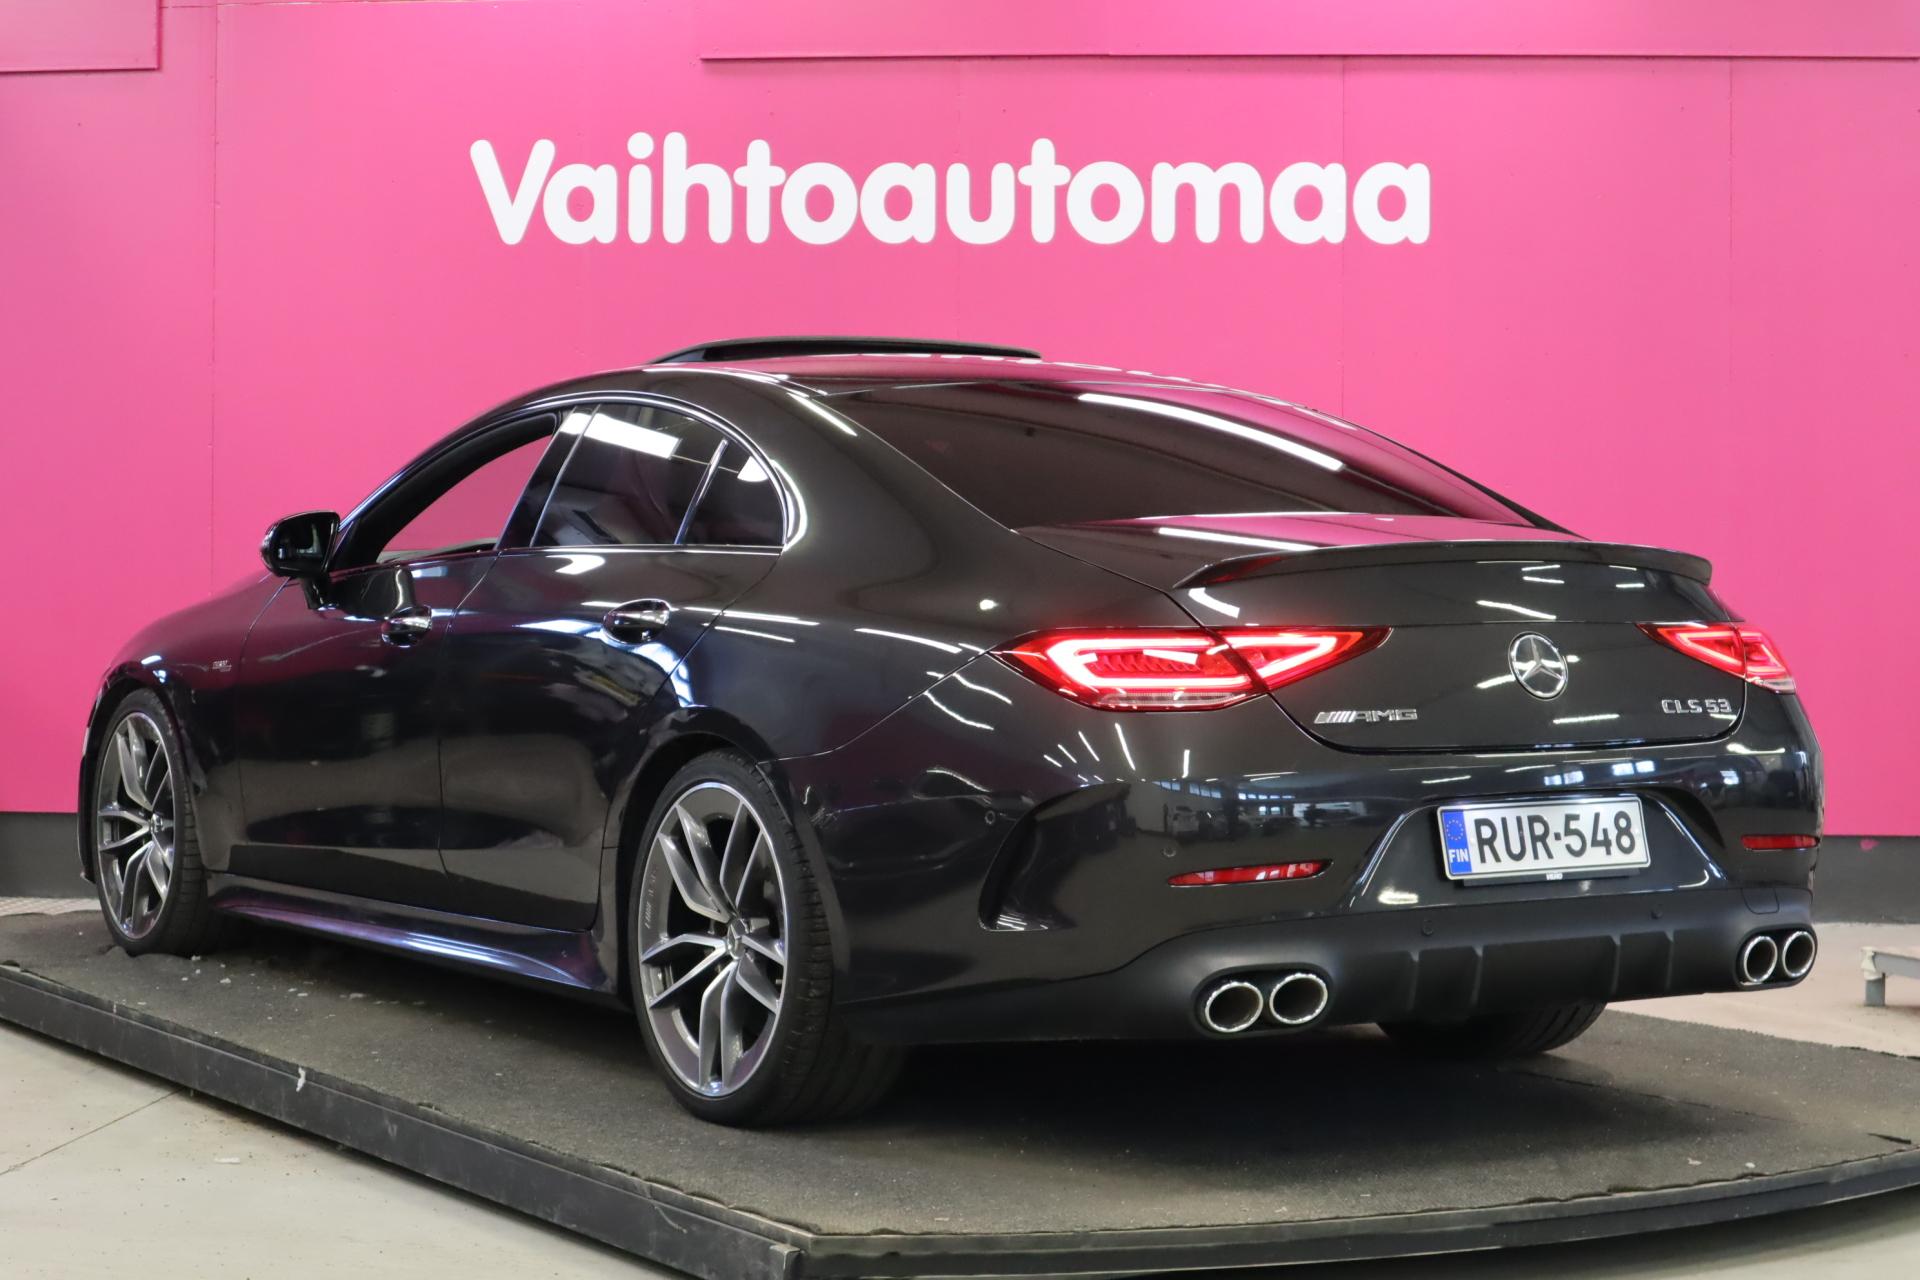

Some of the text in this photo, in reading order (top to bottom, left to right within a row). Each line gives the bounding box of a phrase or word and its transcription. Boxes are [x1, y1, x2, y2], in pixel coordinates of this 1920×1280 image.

[470, 131, 1430, 244] Vaihtoautomaa
[1661, 698, 1732, 713] CLS 53
[1349, 708, 1418, 722] AMG
[1474, 810, 1636, 864] RUR-548
[1448, 848, 1470, 863] FIN
